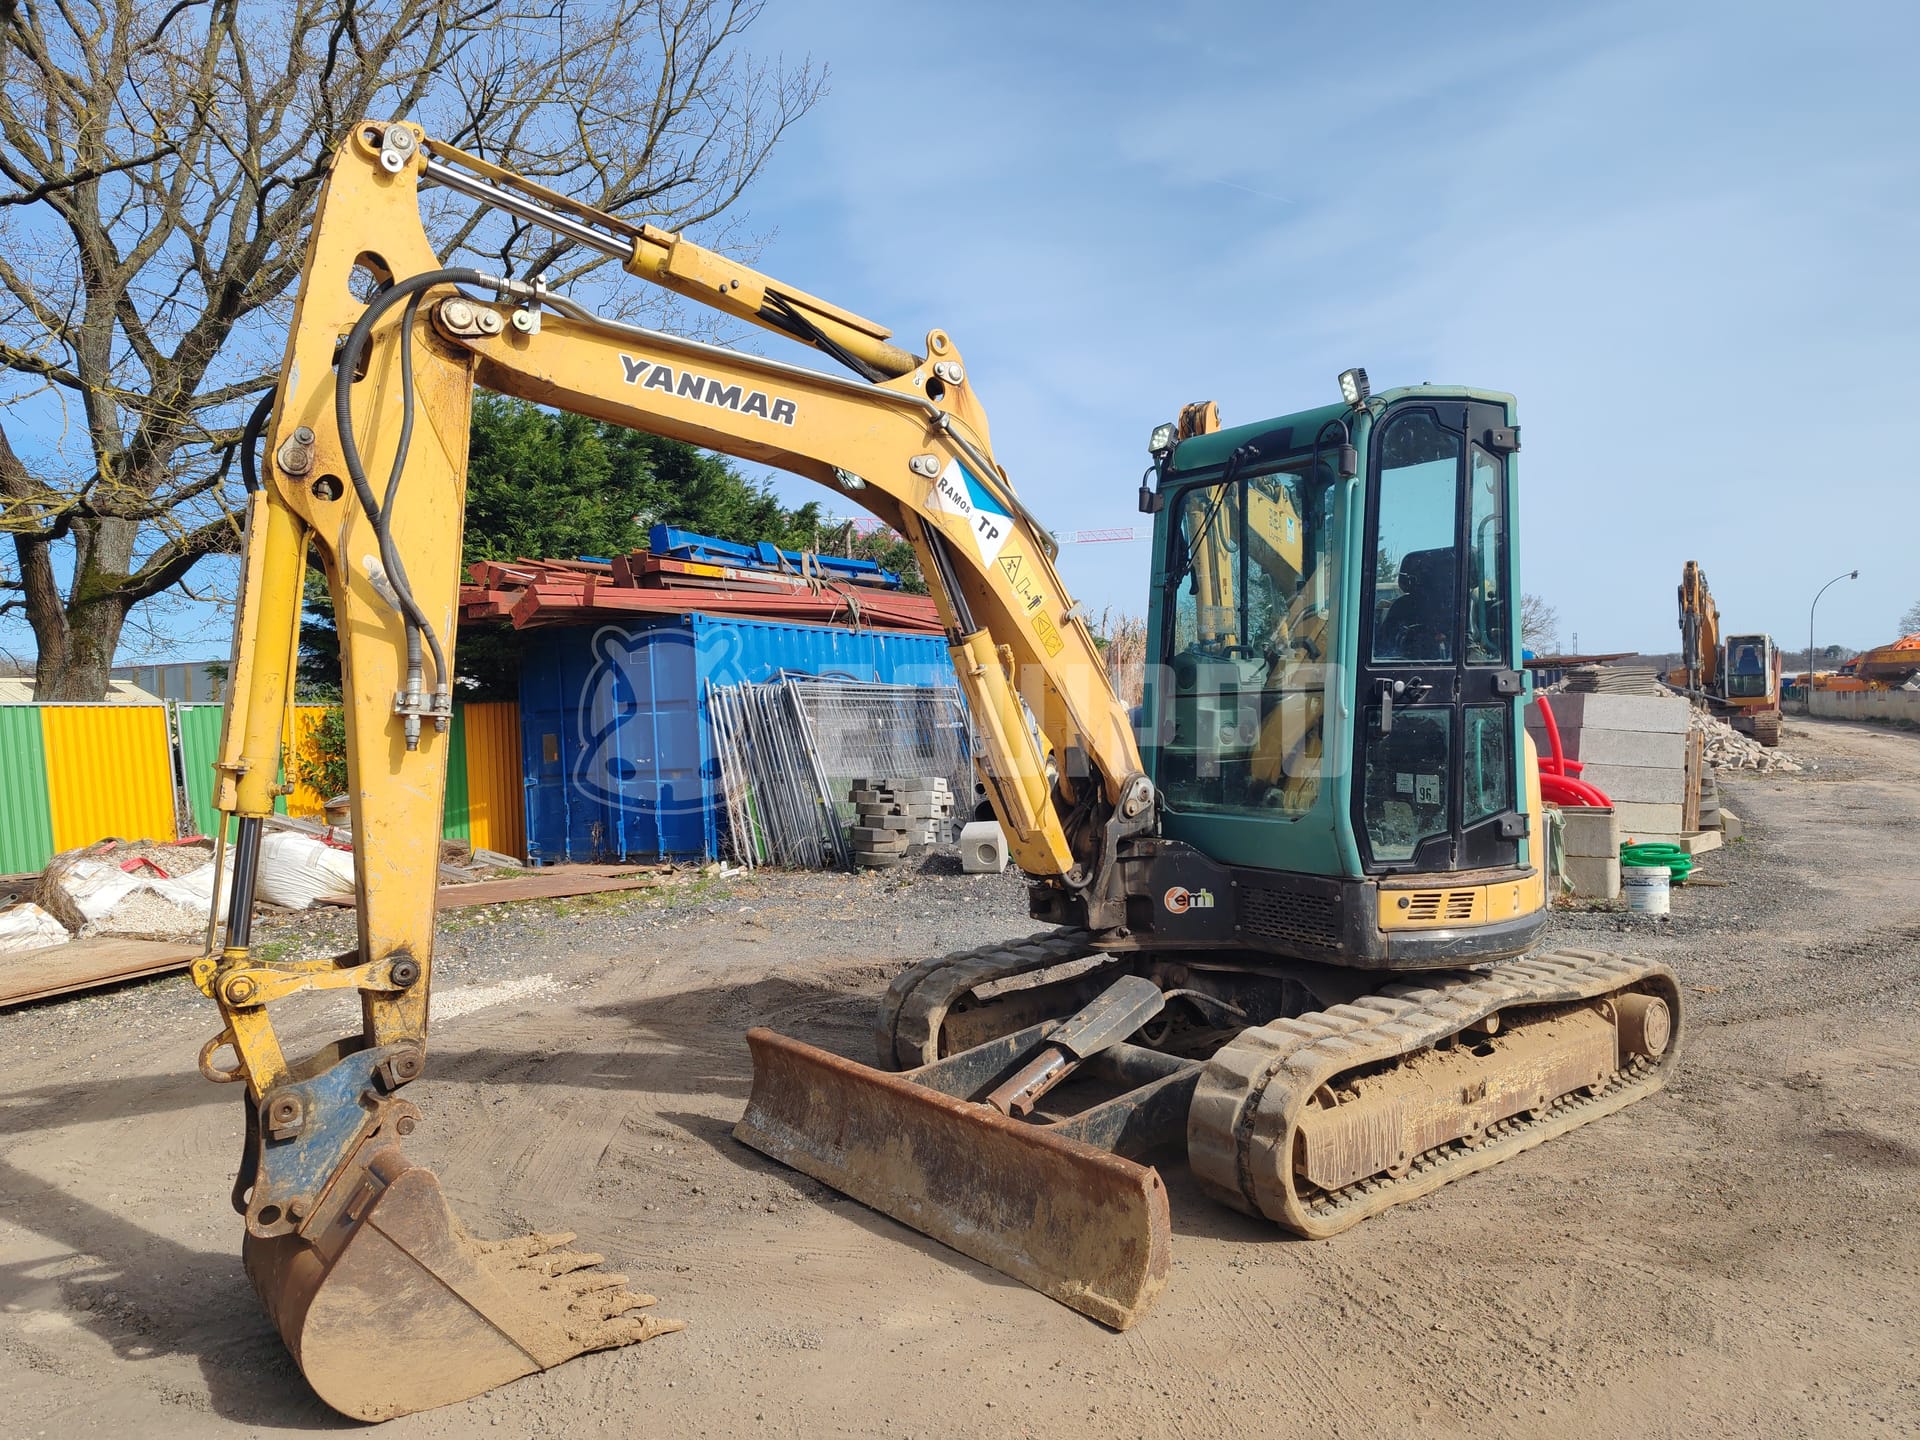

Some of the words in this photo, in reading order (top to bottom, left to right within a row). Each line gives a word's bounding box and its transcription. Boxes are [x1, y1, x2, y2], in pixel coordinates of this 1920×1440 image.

[620, 354, 797, 426] YANMAR
[937, 476, 971, 514] RAMOS
[977, 515, 999, 540] TP
[1419, 787, 1432, 801] 96
